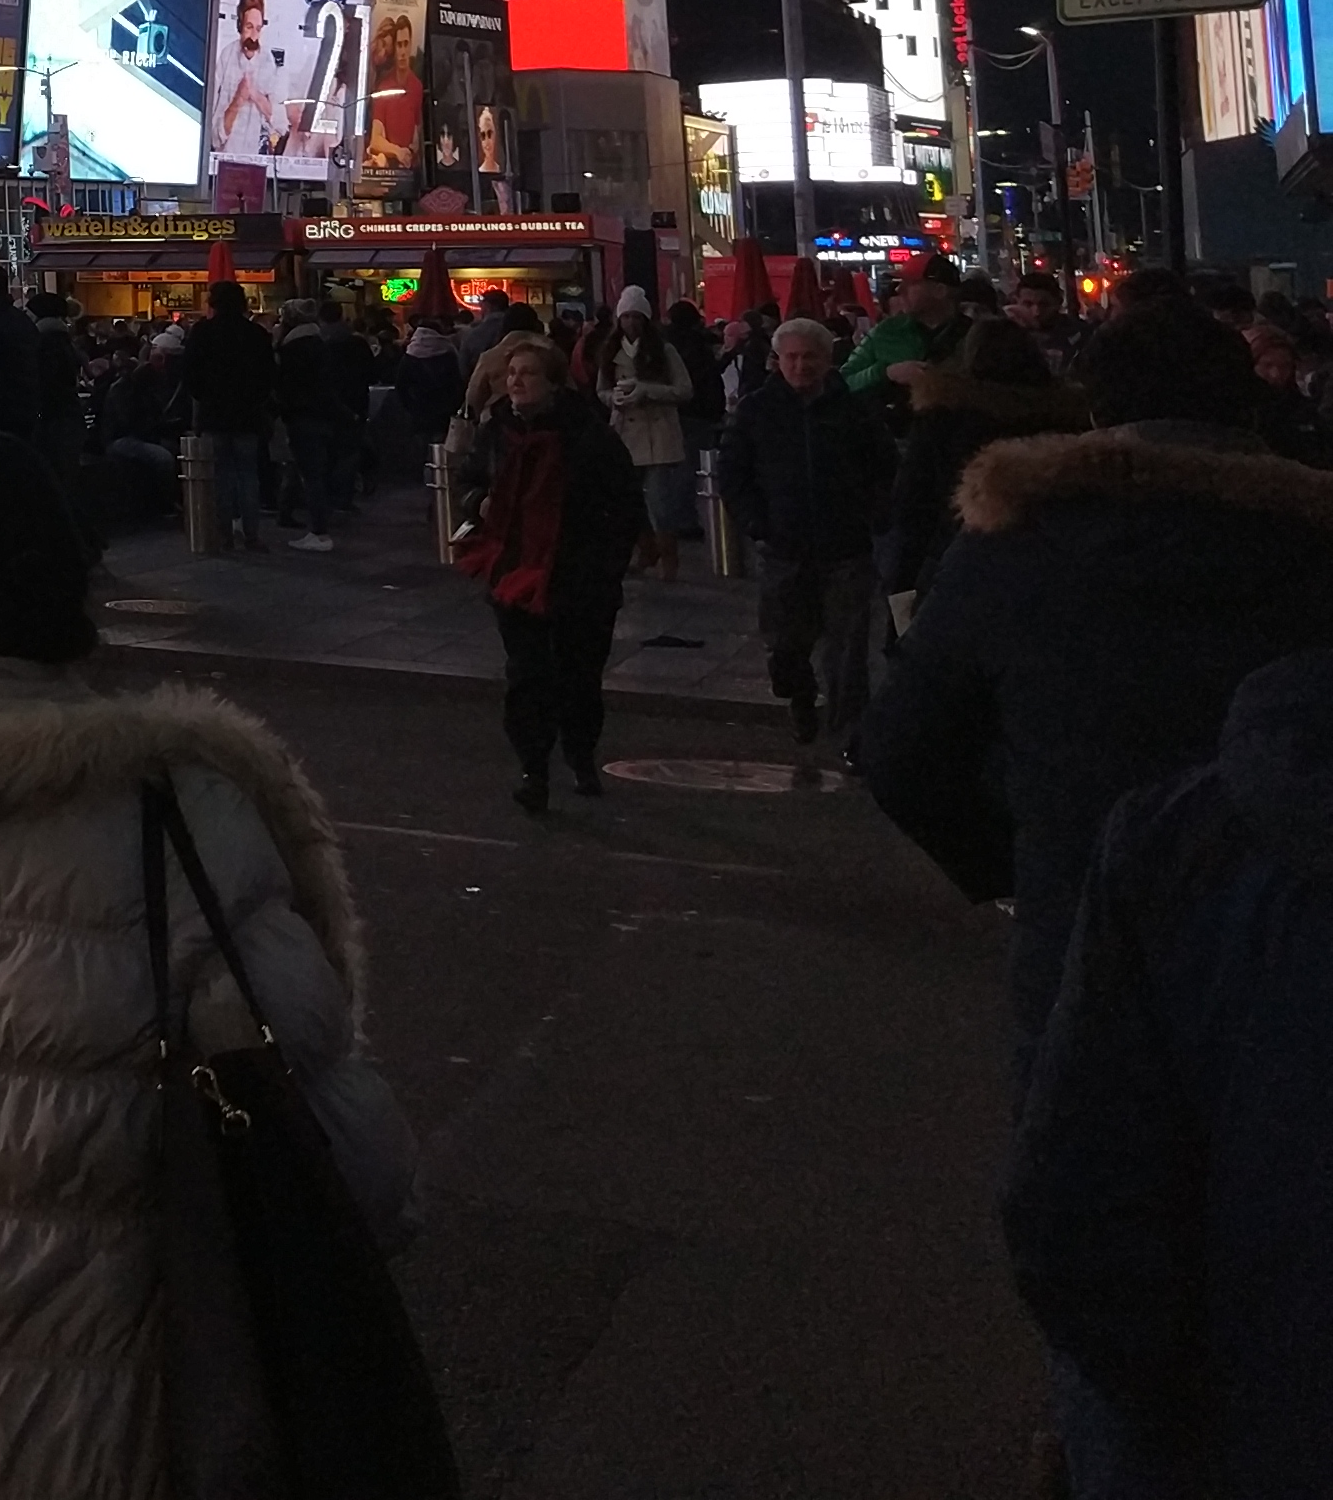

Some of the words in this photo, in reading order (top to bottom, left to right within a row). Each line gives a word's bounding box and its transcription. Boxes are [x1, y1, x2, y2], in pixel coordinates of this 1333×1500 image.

[309, 0, 372, 137] 21
[305, 222, 355, 240] BING
[321, 219, 340, 230] MR
[359, 222, 404, 233] CHINESE
[405, 222, 444, 233] CREPES
[450, 222, 514, 233] DUMPLINGS
[520, 221, 562, 232] BUBBLE
[564, 221, 585, 232] TEA
